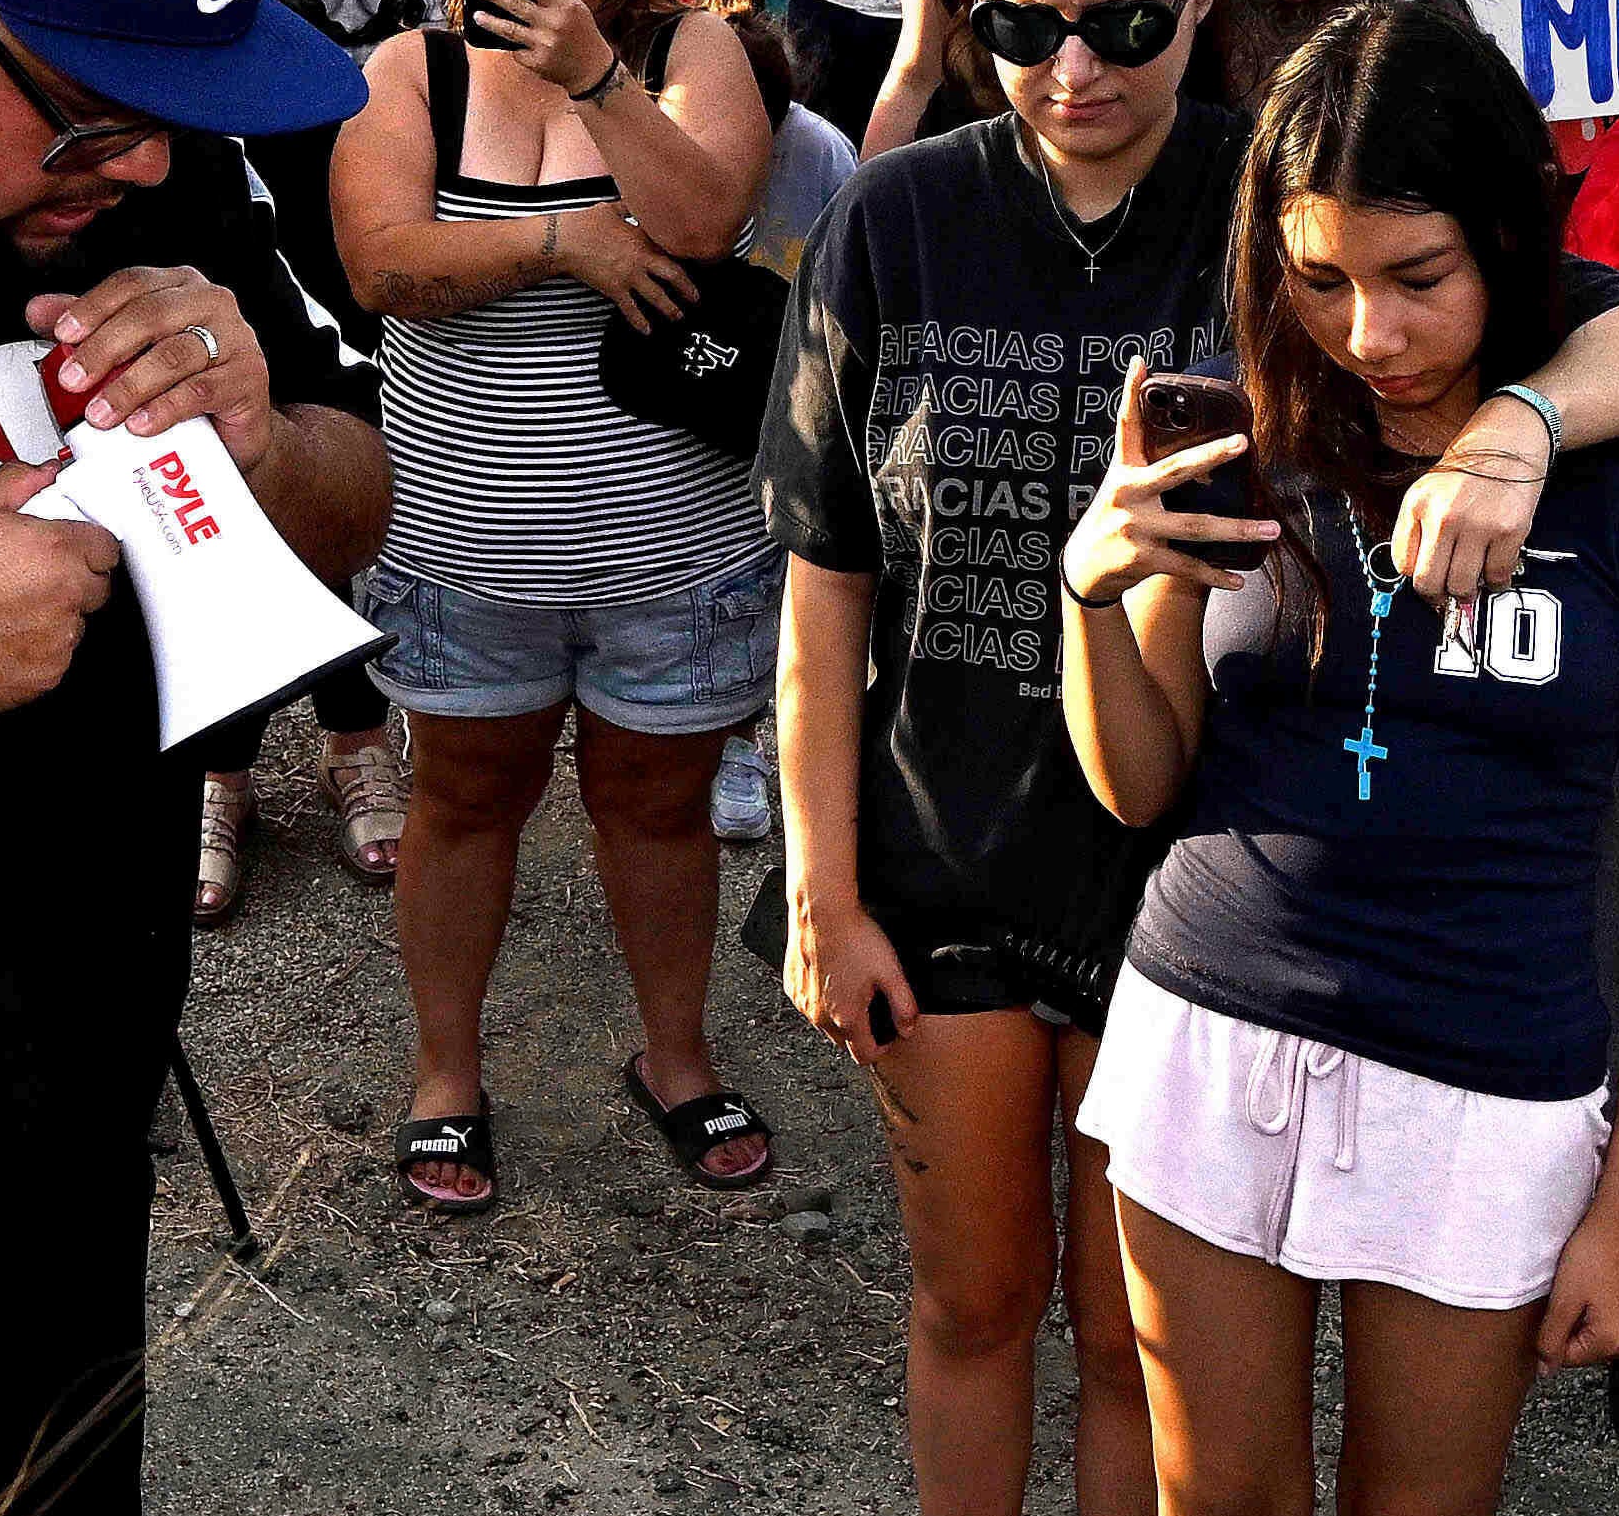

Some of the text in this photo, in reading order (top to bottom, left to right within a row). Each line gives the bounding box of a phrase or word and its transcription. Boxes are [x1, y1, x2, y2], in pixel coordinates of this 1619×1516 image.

[881, 321, 1064, 373] GRACIAS
[1079, 328, 1175, 374] POR
[872, 373, 1060, 423] GRACIAS
[866, 425, 1056, 472] GRACIAS
[148, 450, 220, 545] PYLE
[1019, 683, 1051, 698] Bad
[411, 1139, 458, 1152] PUMA
